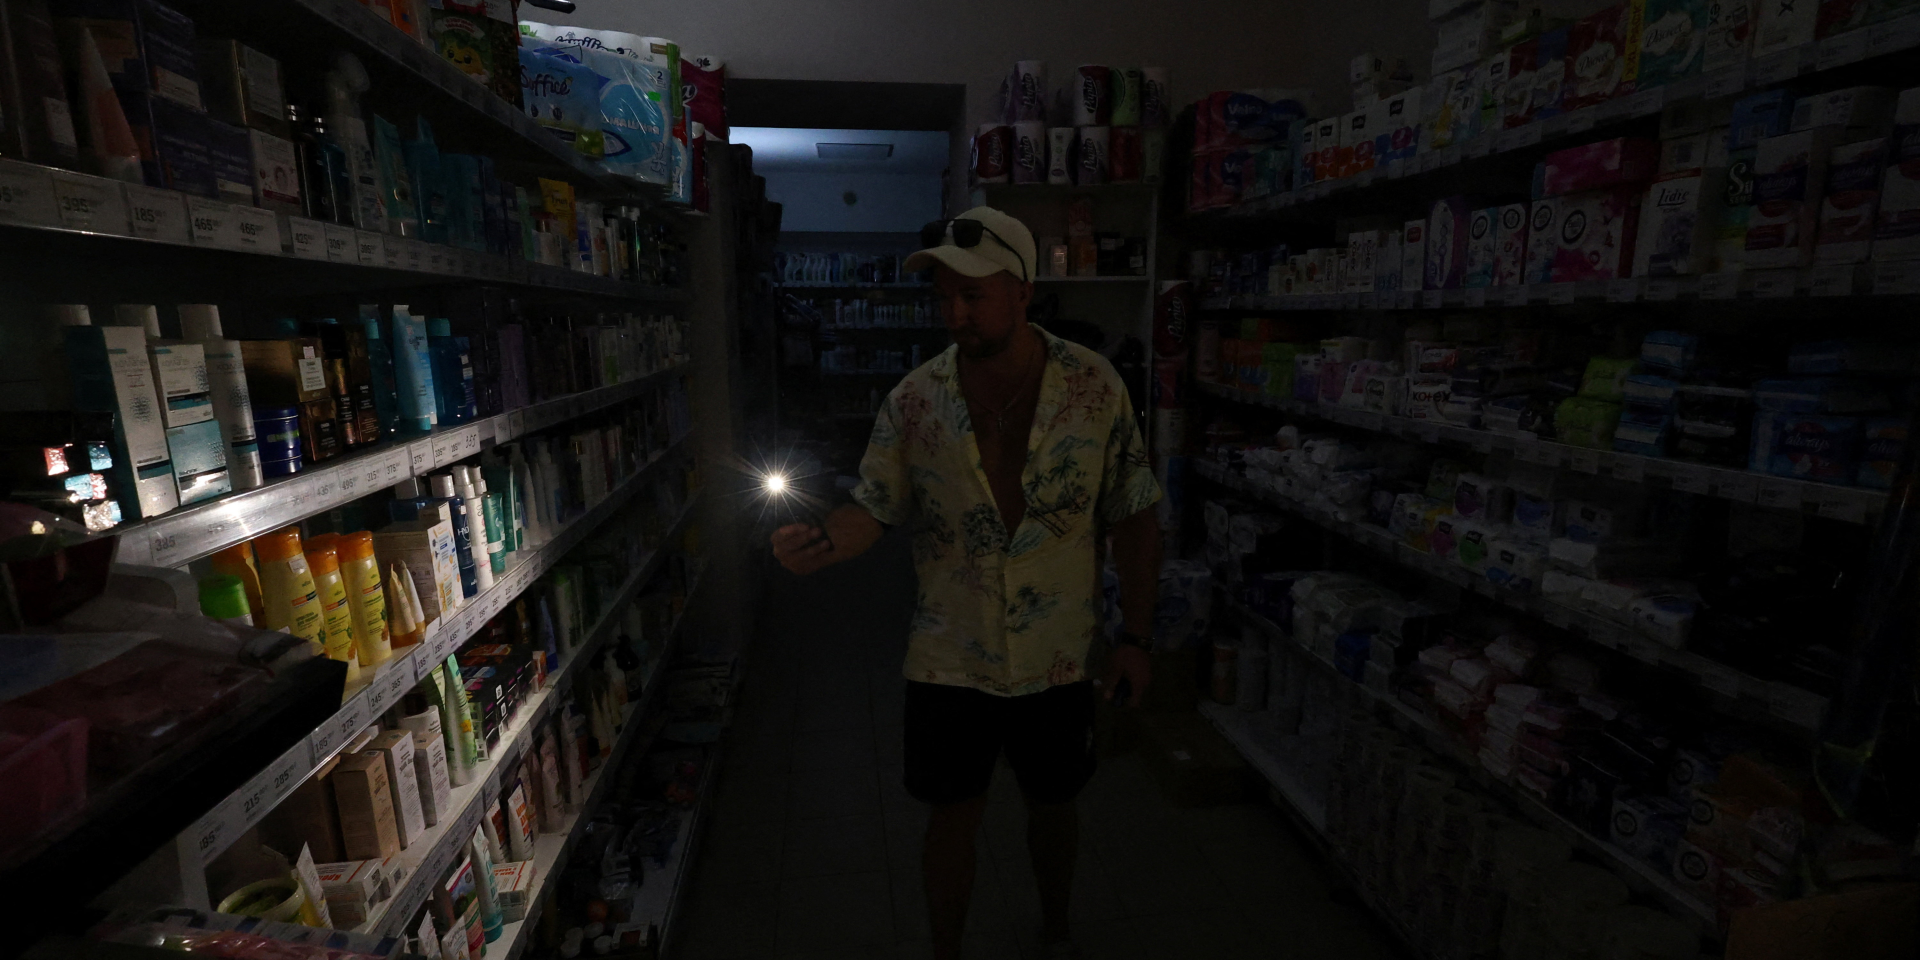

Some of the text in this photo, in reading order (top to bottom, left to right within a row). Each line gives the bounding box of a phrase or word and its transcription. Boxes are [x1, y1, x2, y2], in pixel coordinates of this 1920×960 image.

[657, 71, 664, 80] 2
[1083, 75, 1097, 113] Papia
[1020, 136, 1035, 171] Papia
[1083, 138, 1097, 172] Papia
[62, 196, 90, 213] 395
[1657, 188, 1691, 207] Lidie
[134, 207, 155, 222] 185
[194, 218, 214, 231] 465
[239, 222, 256, 235] 465
[1412, 389, 1450, 403] kotex
[387, 465, 398, 475] 375
[155, 535, 176, 552] 385
[370, 691, 383, 708] 245
[341, 717, 355, 734] 275
[273, 769, 290, 790] 285
[243, 792, 260, 814] 215
